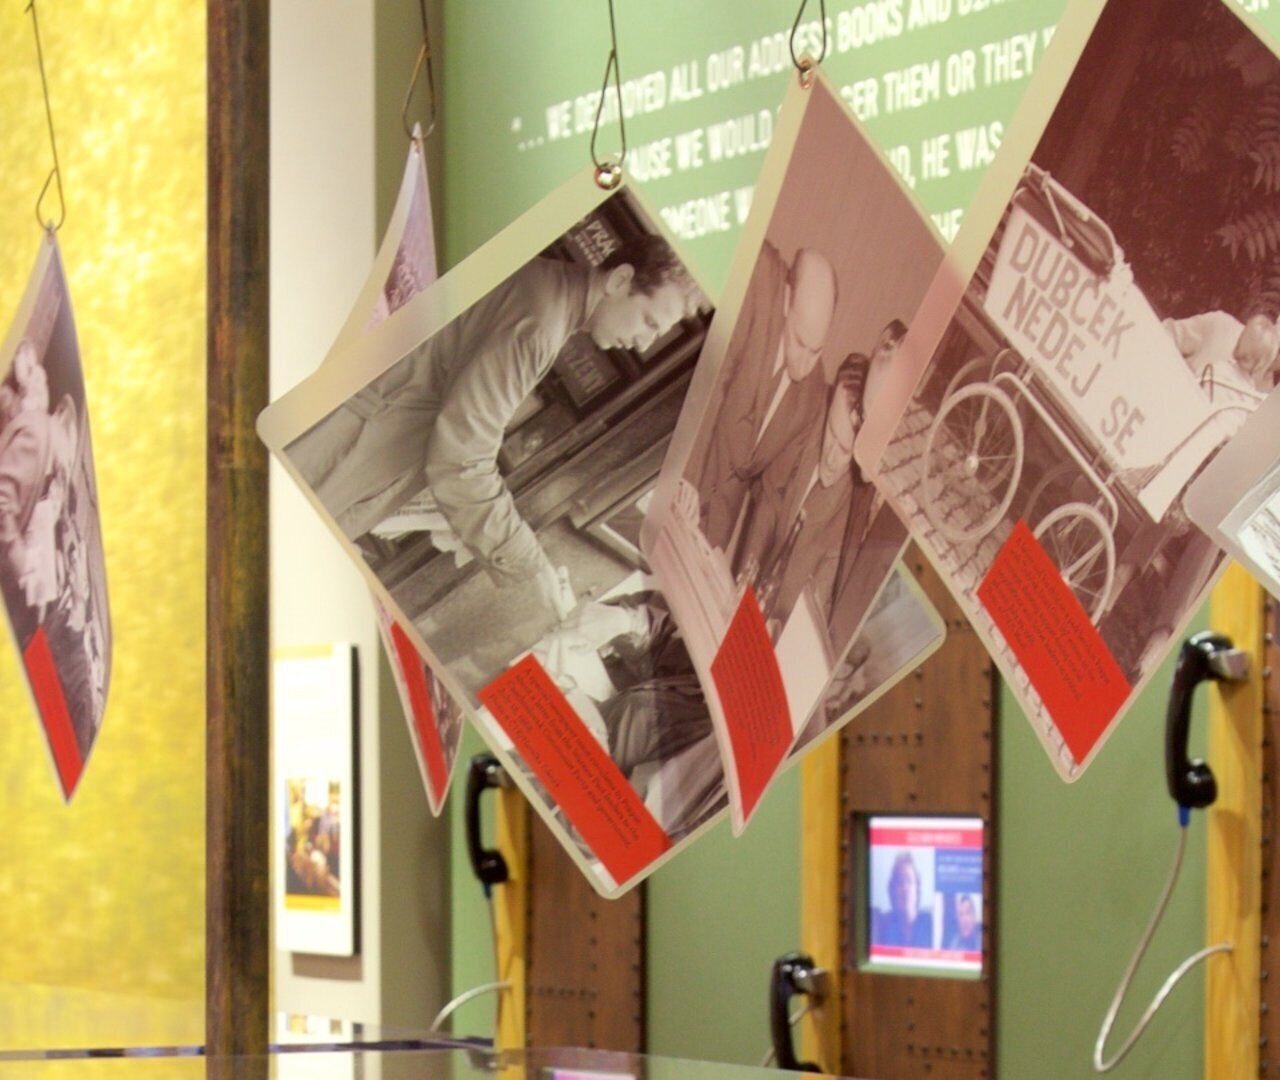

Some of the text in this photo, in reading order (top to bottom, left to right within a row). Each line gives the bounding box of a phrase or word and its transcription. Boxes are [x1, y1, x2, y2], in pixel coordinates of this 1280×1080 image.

[545, 99, 573, 141] WE
[668, 58, 704, 103] ALL
[706, 44, 746, 93] OUR
[835, 0, 904, 54] BOOKS
[674, 127, 705, 172] WE
[706, 107, 773, 163] WOULD
[882, 58, 942, 116] THEM
[945, 48, 978, 98] OR
[980, 29, 1039, 87] THEY
[921, 133, 952, 182] HE
[954, 120, 1006, 173] WAS
[1002, 274, 1103, 398] NEDEJ
[1099, 394, 1147, 457] SE
